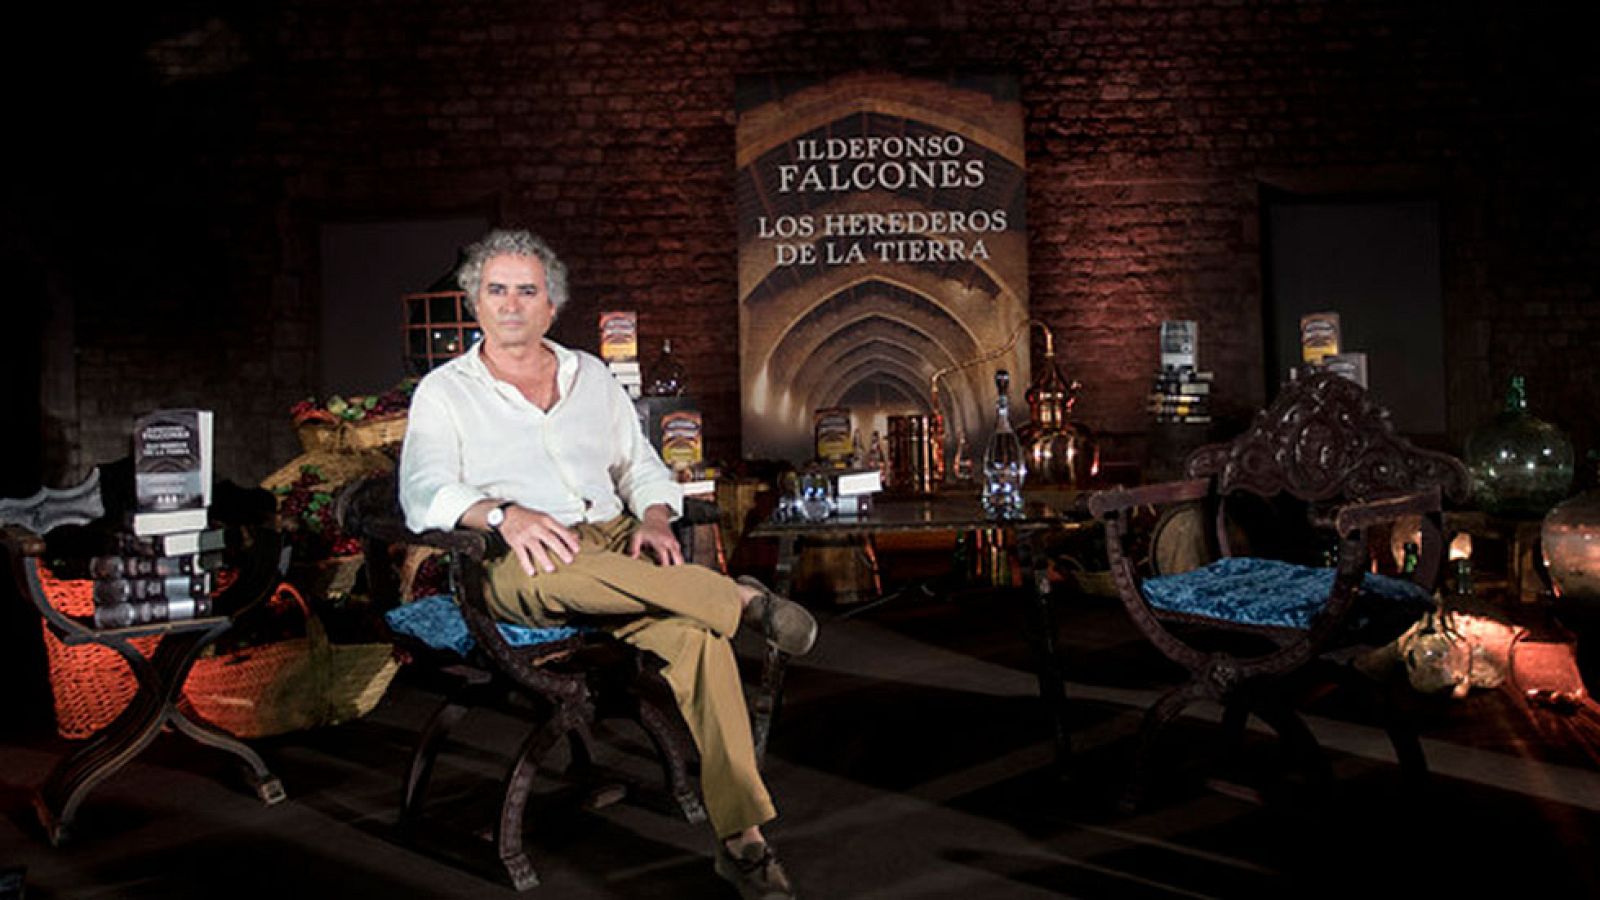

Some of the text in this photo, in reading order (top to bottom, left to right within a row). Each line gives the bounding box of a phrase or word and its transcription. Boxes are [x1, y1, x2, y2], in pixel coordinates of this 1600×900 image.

[796, 135, 965, 160] ILDEFONSO
[777, 159, 986, 192] FALCONES
[758, 210, 1008, 239] LOS HEREDEROS
[775, 240, 991, 267] DE LA TIERRA
